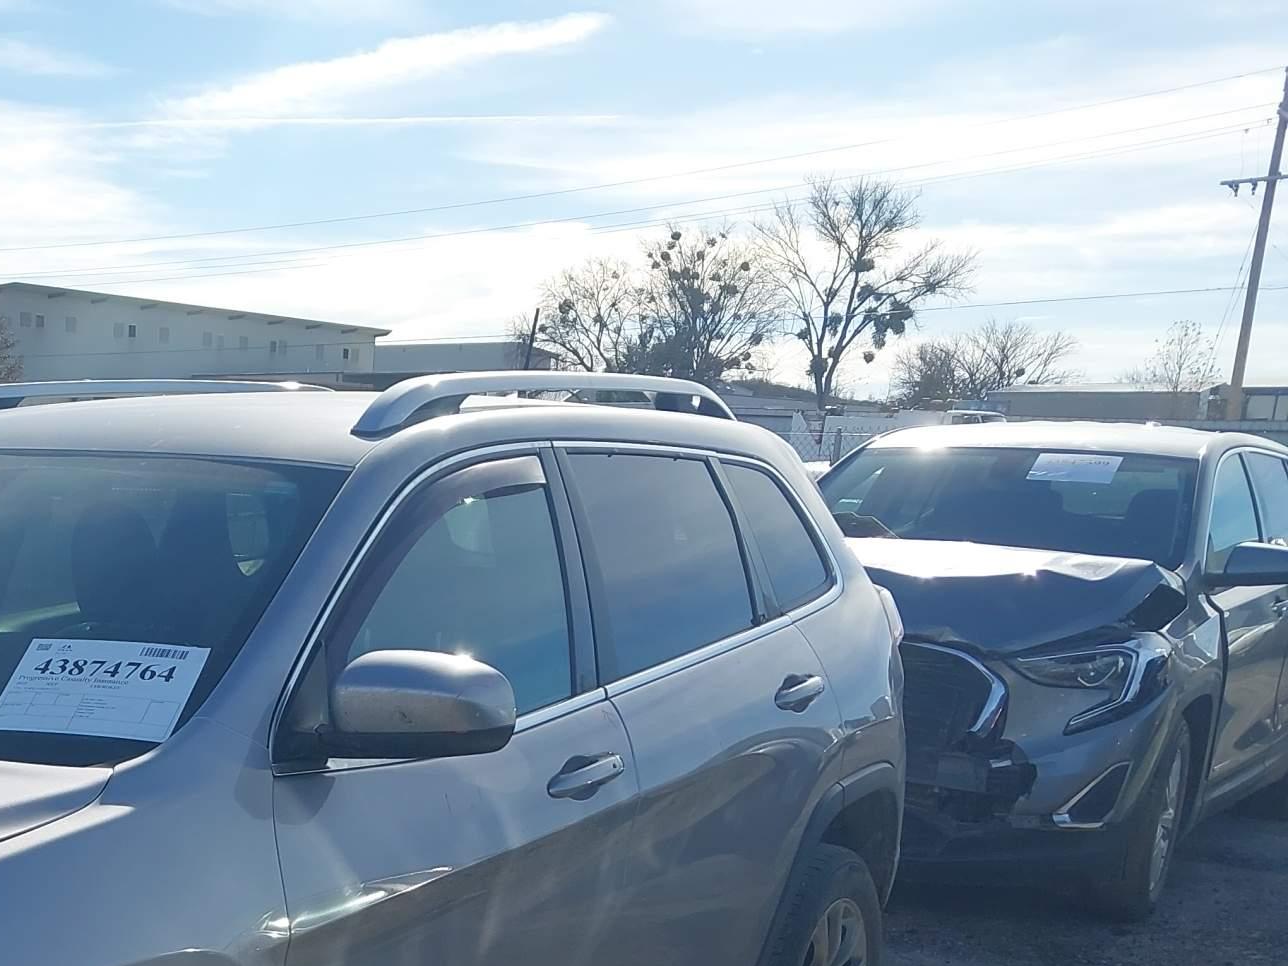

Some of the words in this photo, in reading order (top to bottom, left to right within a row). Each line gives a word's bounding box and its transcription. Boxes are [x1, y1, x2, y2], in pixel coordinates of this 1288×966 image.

[18, 674, 59, 682] Progressive
[60, 675, 92, 684] Casualty
[34, 658, 177, 683] 43874764
